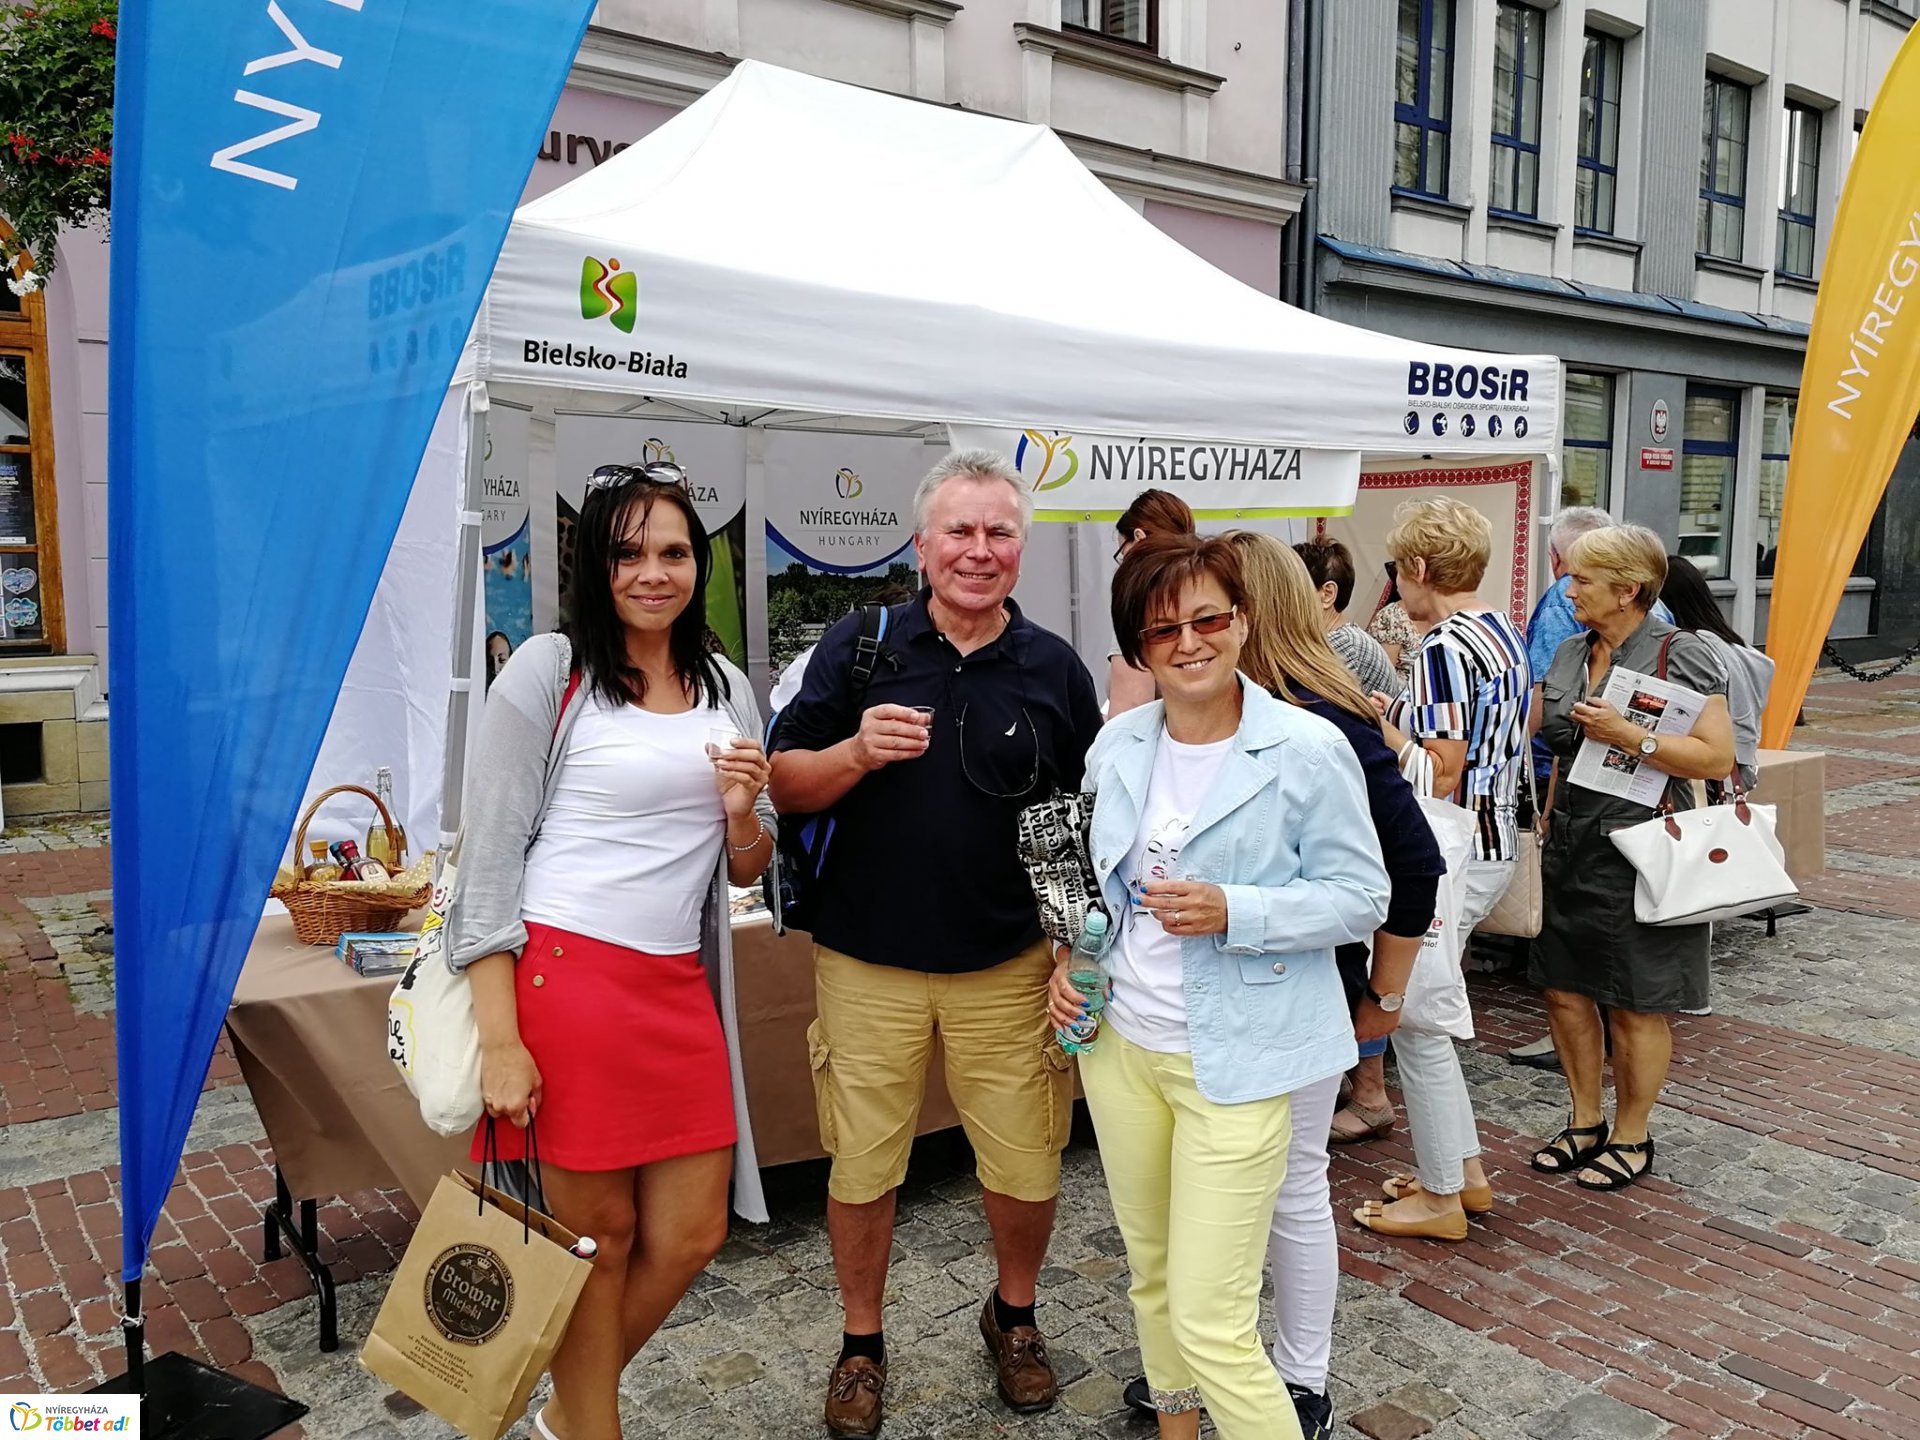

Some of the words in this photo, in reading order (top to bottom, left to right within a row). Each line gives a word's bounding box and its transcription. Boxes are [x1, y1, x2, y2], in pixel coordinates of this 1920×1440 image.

[523, 339, 688, 379] Bielsko-Biała
[1407, 360, 1530, 402] BBOSiR
[483, 474, 521, 498] YHÁZA
[688, 482, 720, 502] ÁZA
[799, 507, 899, 526] NYÍREGYHÁZA
[818, 535, 881, 546] HUNGARY
[440, 1264, 500, 1312] Browar
[442, 1287, 482, 1321] Miejski
